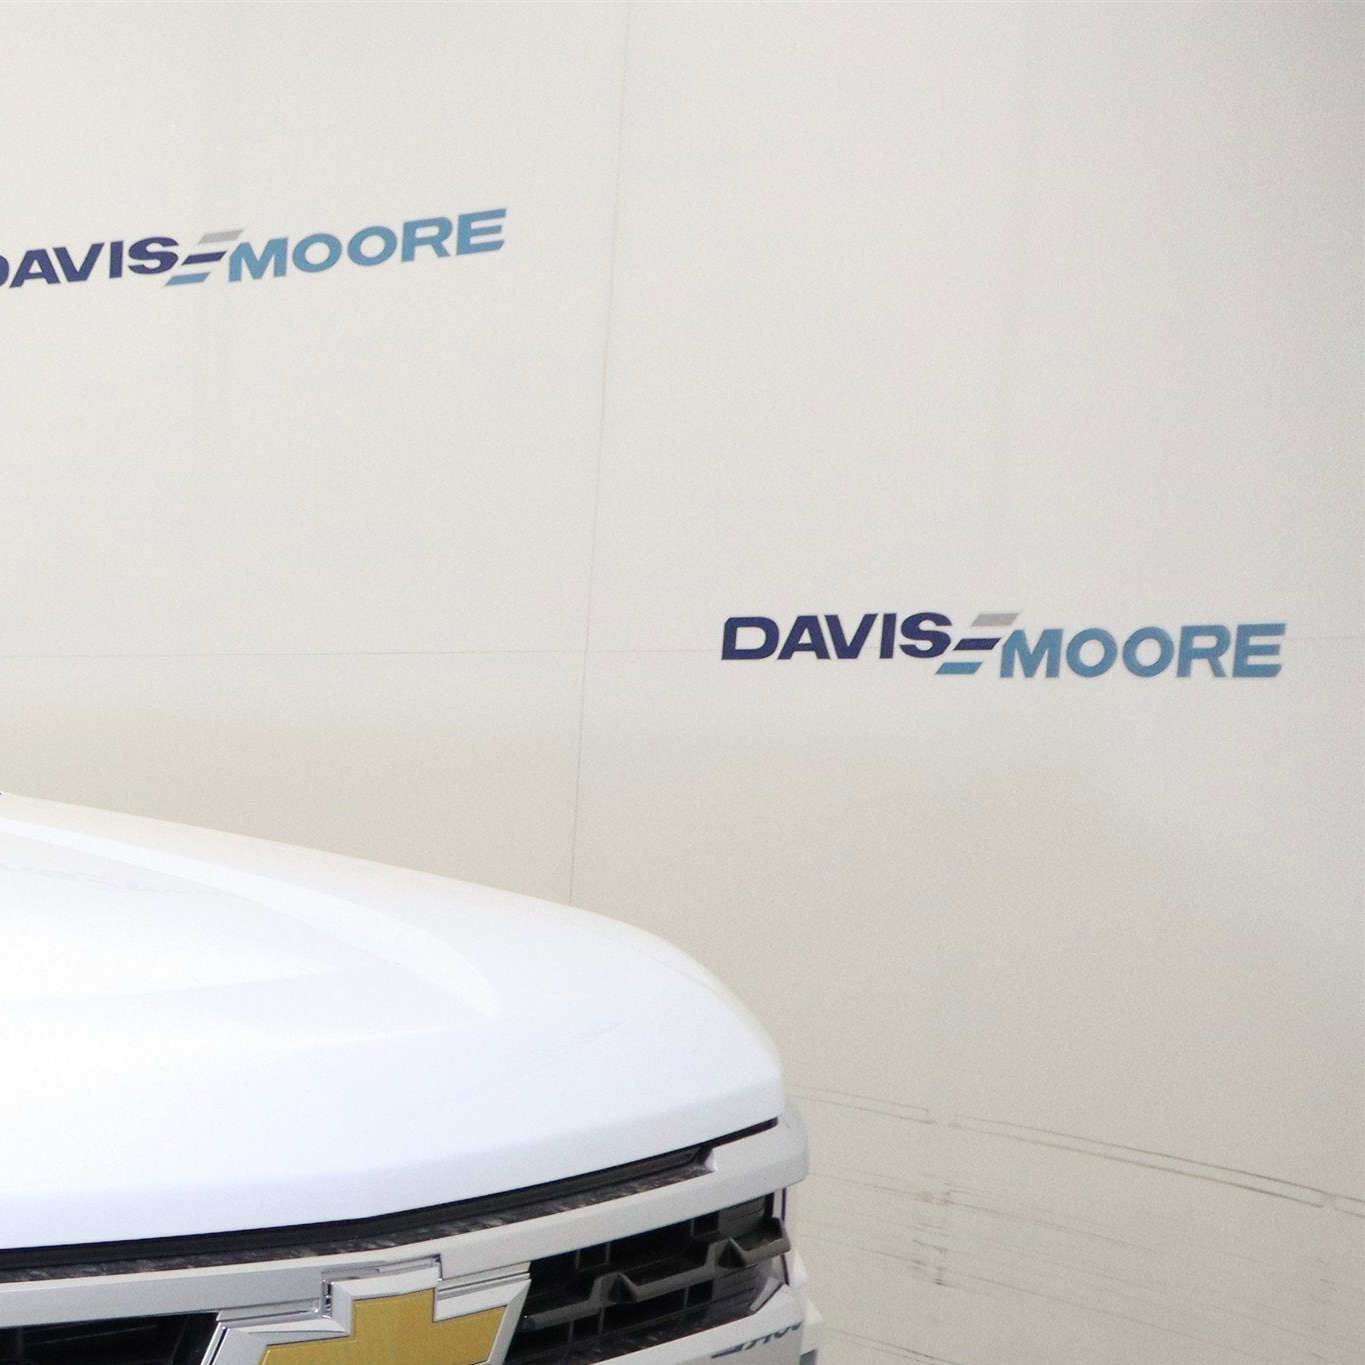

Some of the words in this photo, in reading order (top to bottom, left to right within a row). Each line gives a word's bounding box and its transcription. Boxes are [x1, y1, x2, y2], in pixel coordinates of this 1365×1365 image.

[227, 207, 508, 284] MOORE
[720, 611, 953, 661] DAVIS
[999, 622, 1288, 679] MOORE
